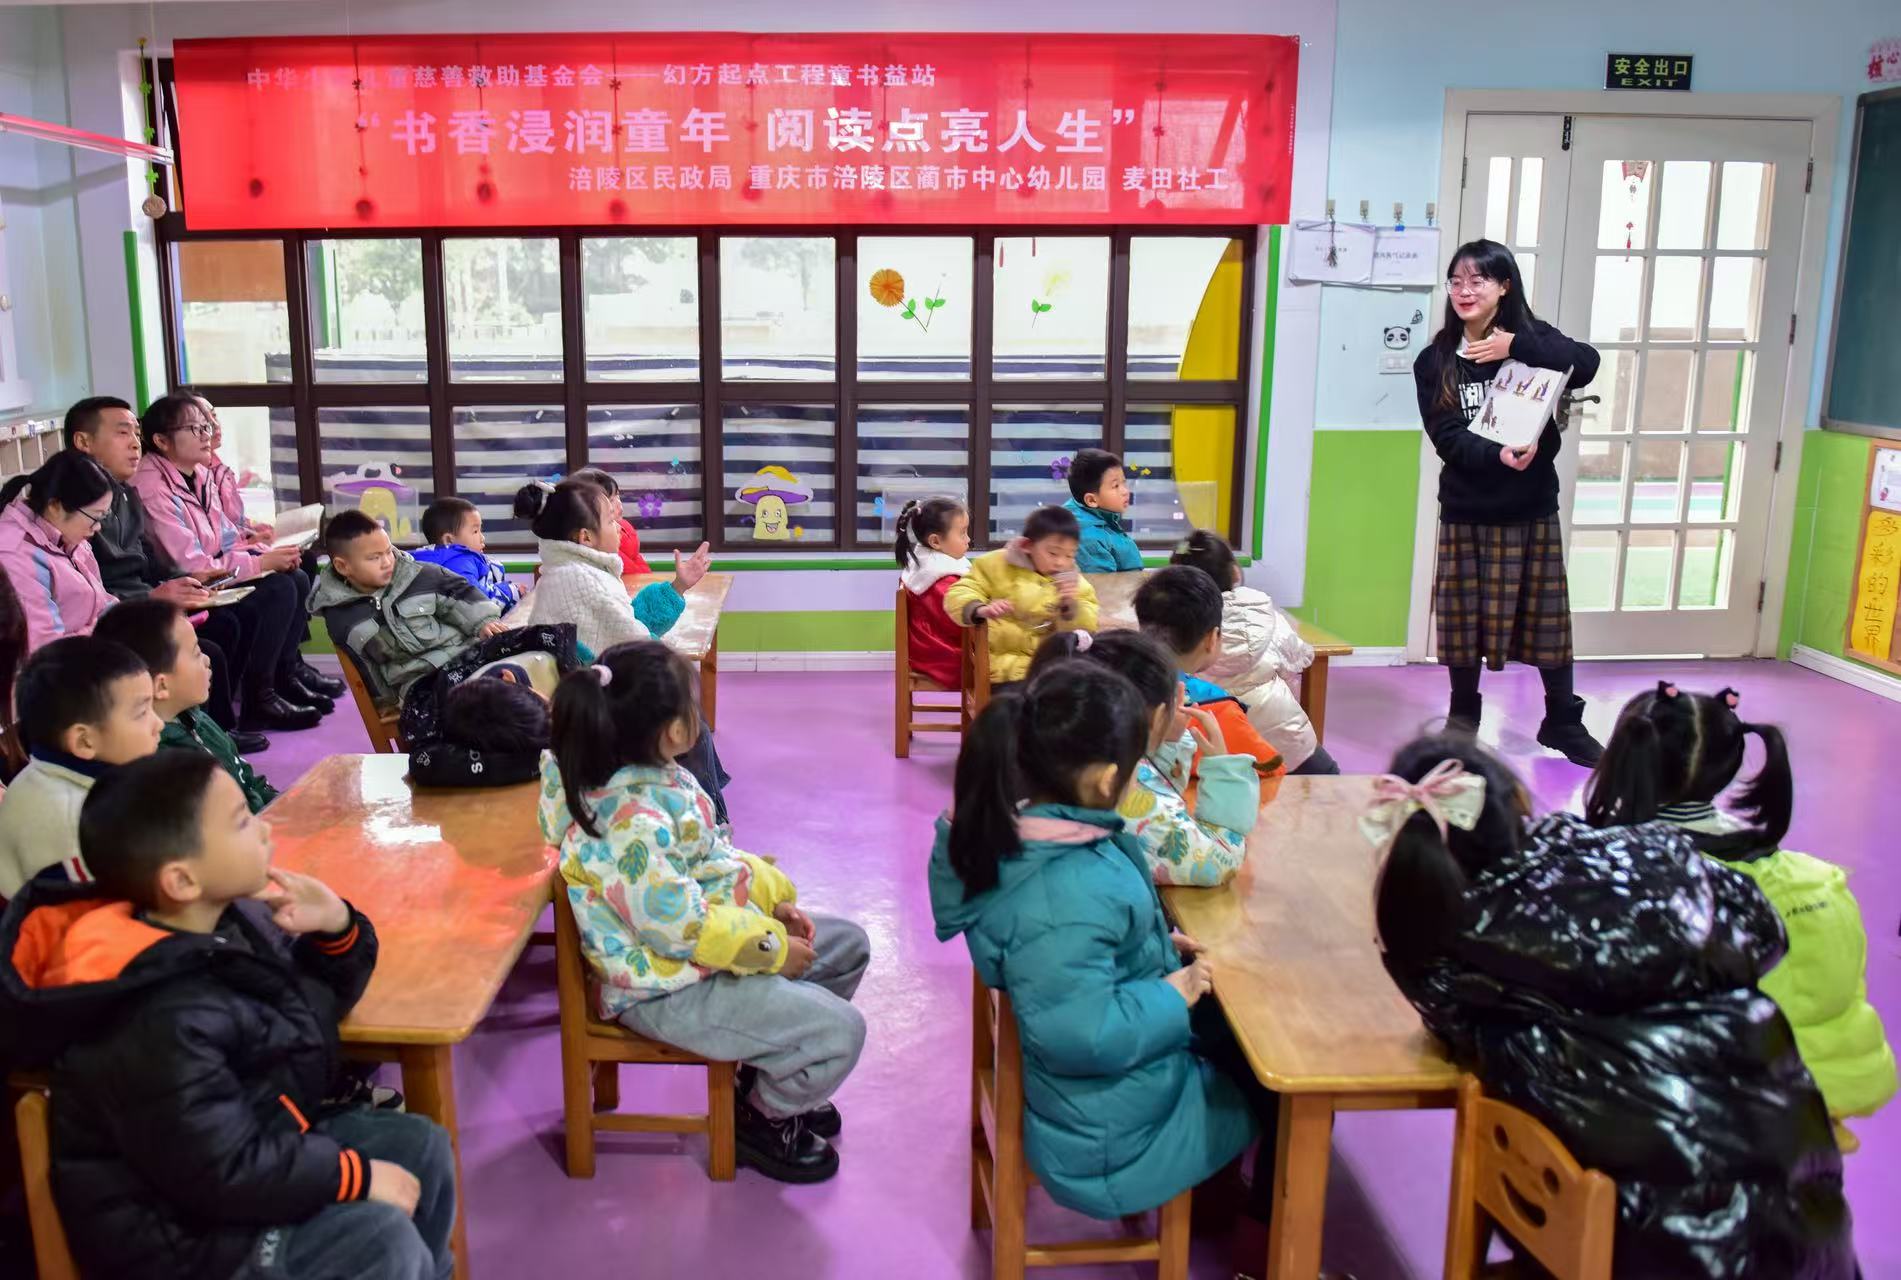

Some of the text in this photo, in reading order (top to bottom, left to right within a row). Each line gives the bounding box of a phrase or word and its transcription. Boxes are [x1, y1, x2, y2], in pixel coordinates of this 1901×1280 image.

[1614, 57, 1688, 76] 安全出口
[1621, 78, 1678, 87] EXIT
[356, 107, 1135, 155] “书香浸润童年 阅读点亮人生”
[568, 164, 1229, 191] 涪陵区民政局 重庆市涪陵区蔺市中心幼儿园 麦田社工
